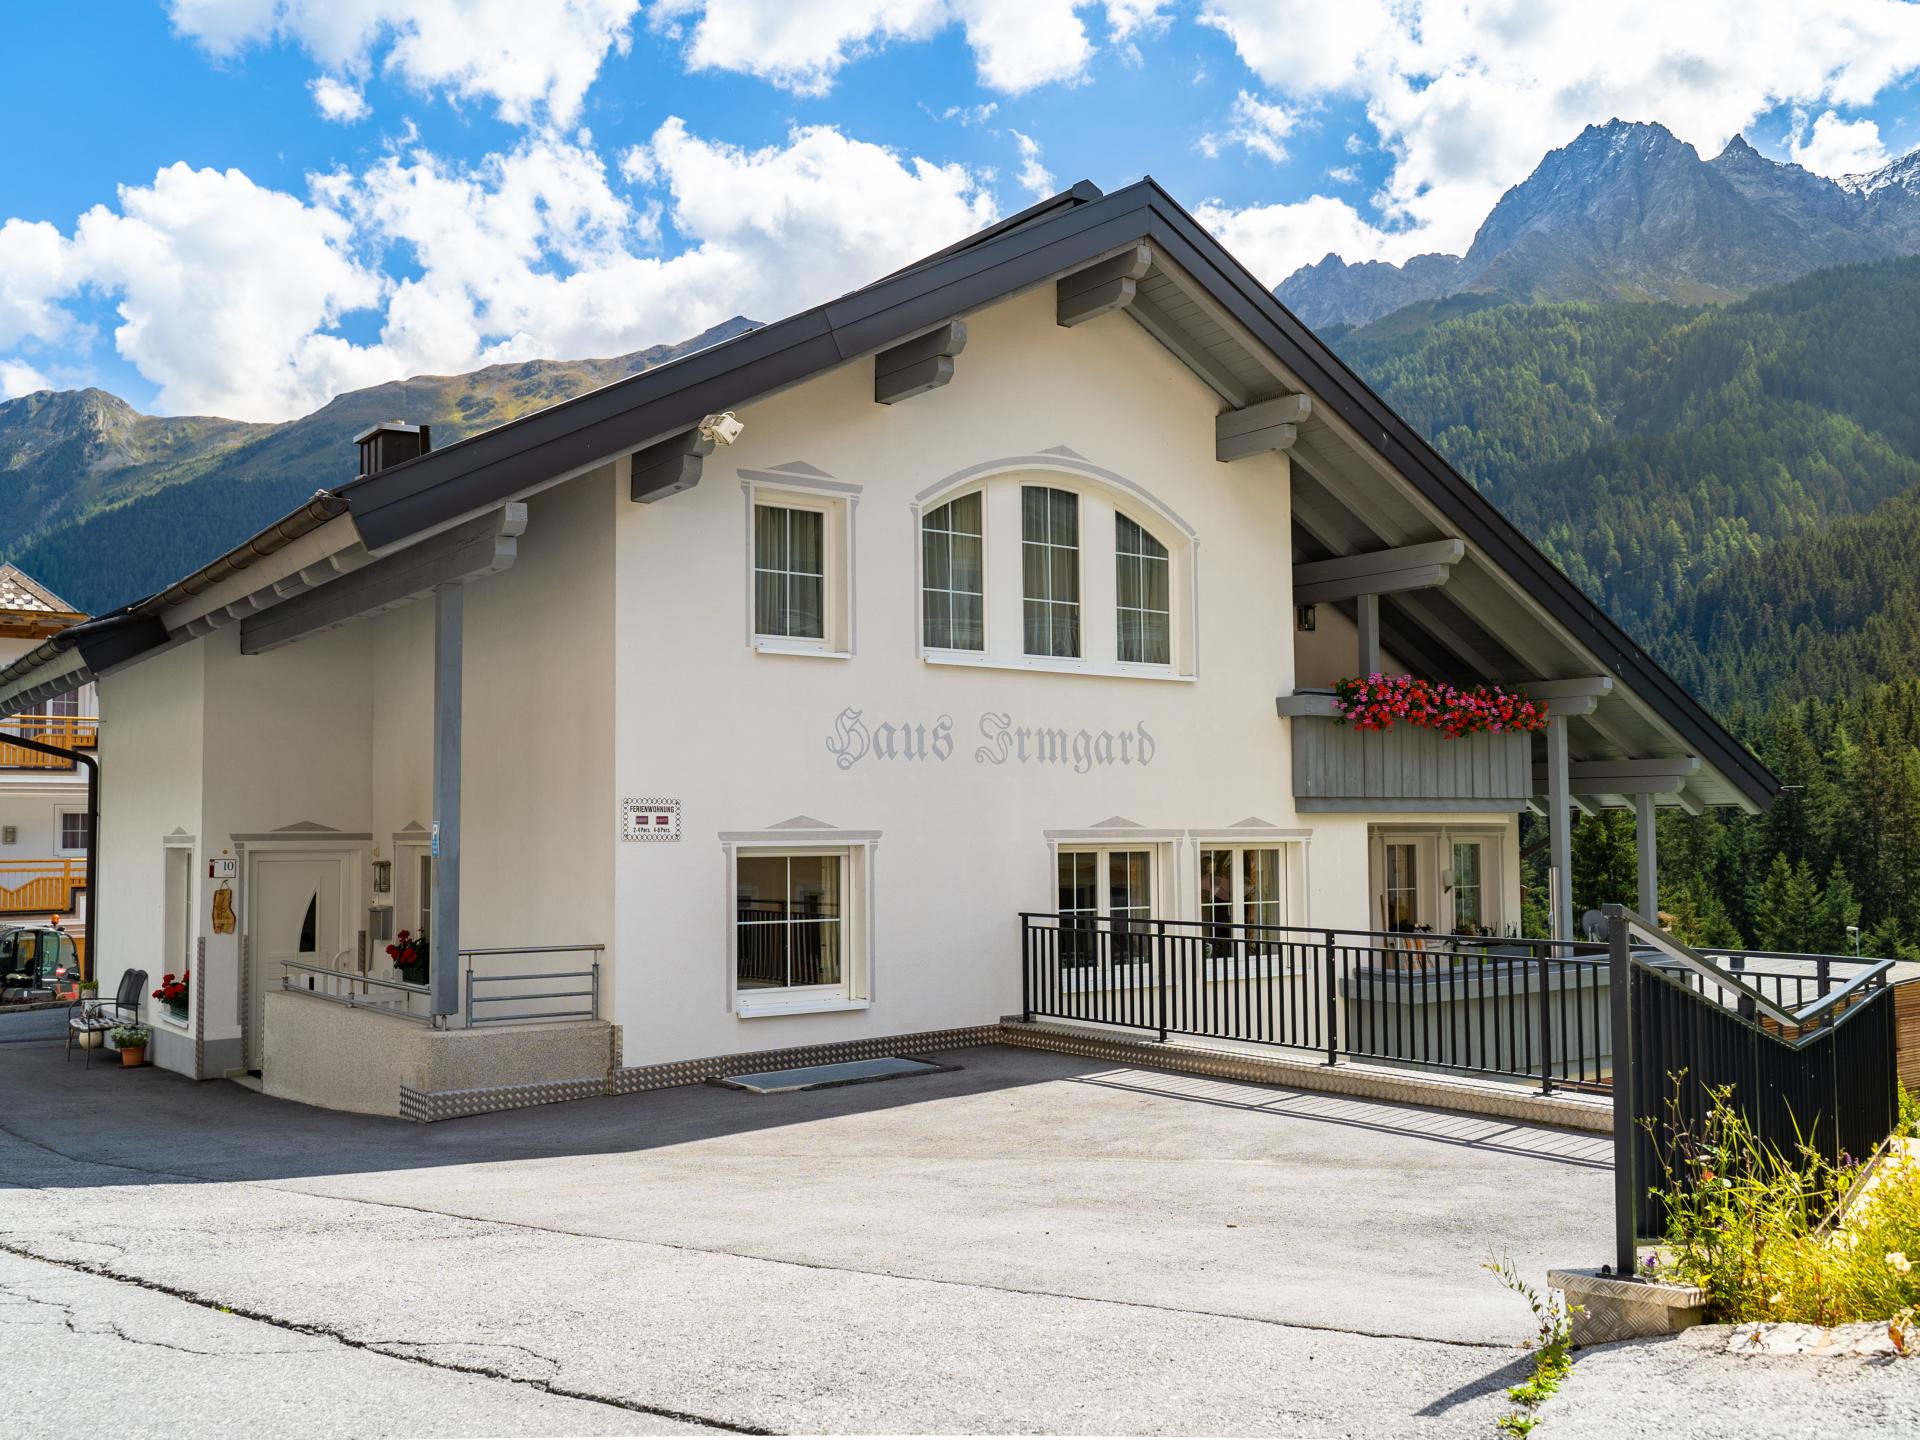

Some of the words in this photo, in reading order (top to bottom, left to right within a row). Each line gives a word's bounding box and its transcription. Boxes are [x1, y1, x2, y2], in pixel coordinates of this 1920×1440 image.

[826, 706, 954, 770] Haus
[974, 712, 1156, 774] Irmgard
[629, 805, 675, 813] FERIENWOHNUNG
[223, 861, 234, 871] 10
